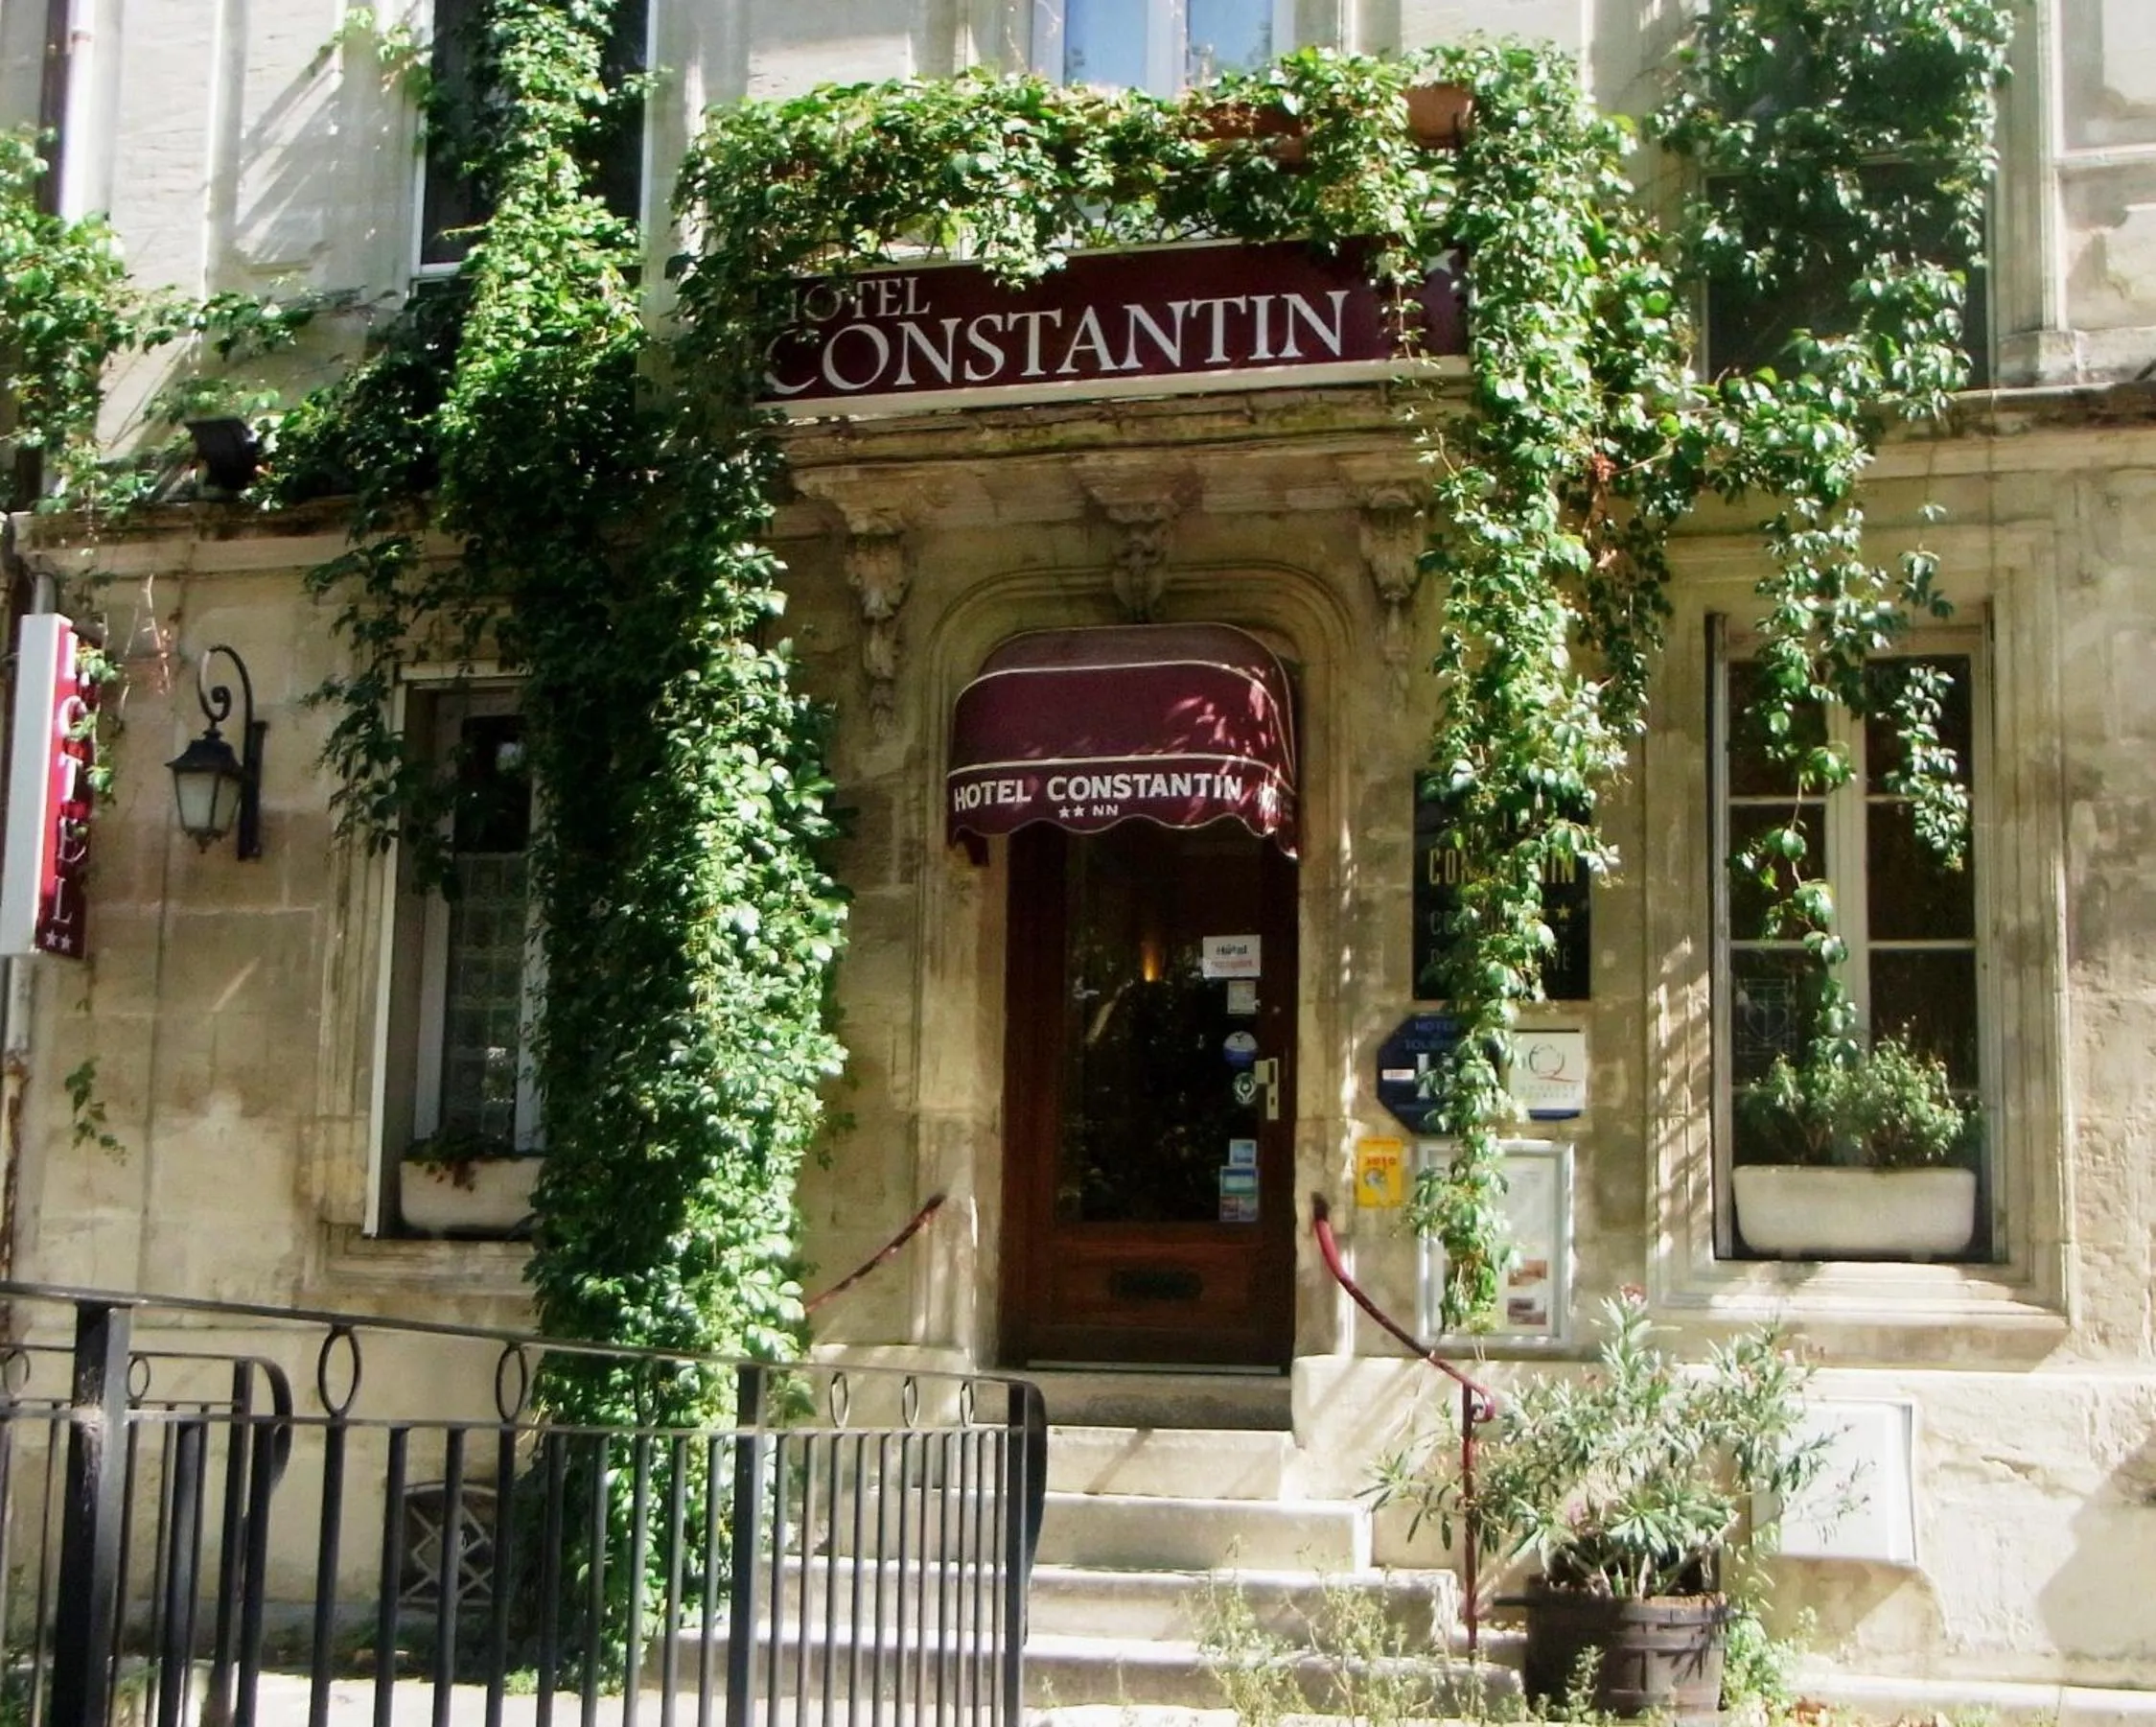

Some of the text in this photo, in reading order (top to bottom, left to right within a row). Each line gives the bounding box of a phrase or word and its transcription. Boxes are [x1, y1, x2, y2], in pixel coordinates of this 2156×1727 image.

[763, 290, 1350, 395] CONSTANTIN
[953, 772, 1244, 813] HOTEL CONSTANTIN
[1091, 804, 1120, 817] NN
